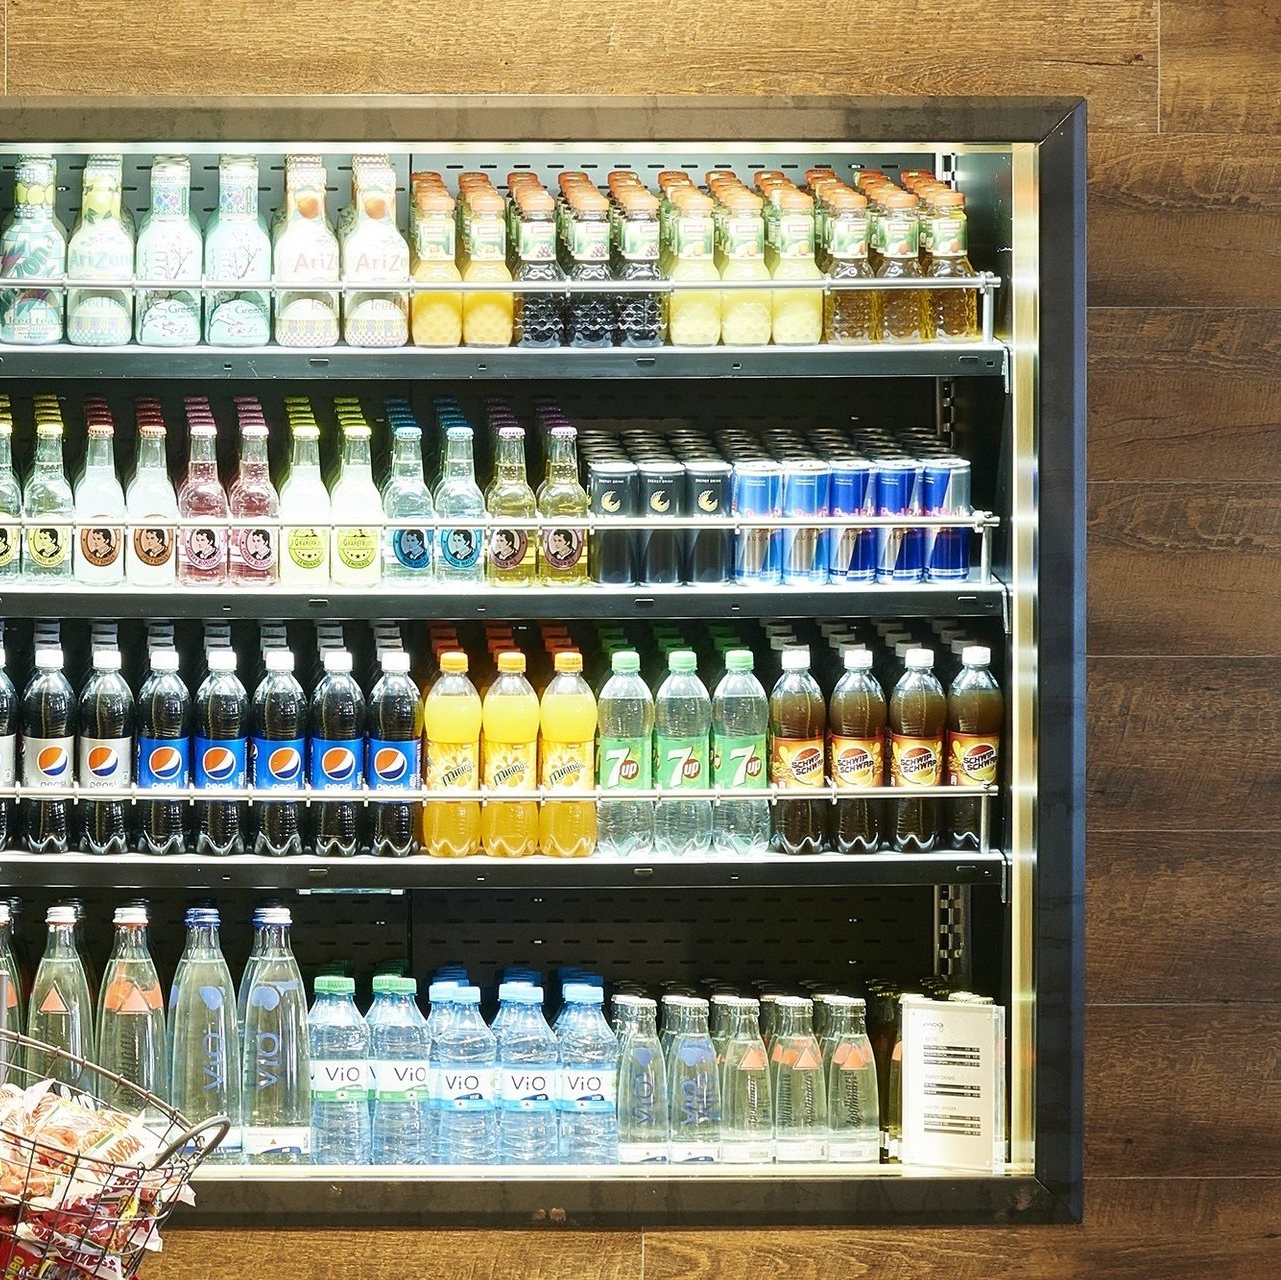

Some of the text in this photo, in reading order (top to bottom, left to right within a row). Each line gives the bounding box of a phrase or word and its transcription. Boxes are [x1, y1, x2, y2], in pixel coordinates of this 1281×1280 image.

[325, 1066, 360, 1082] ViO
[394, 1066, 427, 1082] ViO
[446, 1074, 479, 1090] ViO
[511, 1075, 546, 1091] ViO
[568, 1075, 602, 1091] ViO
